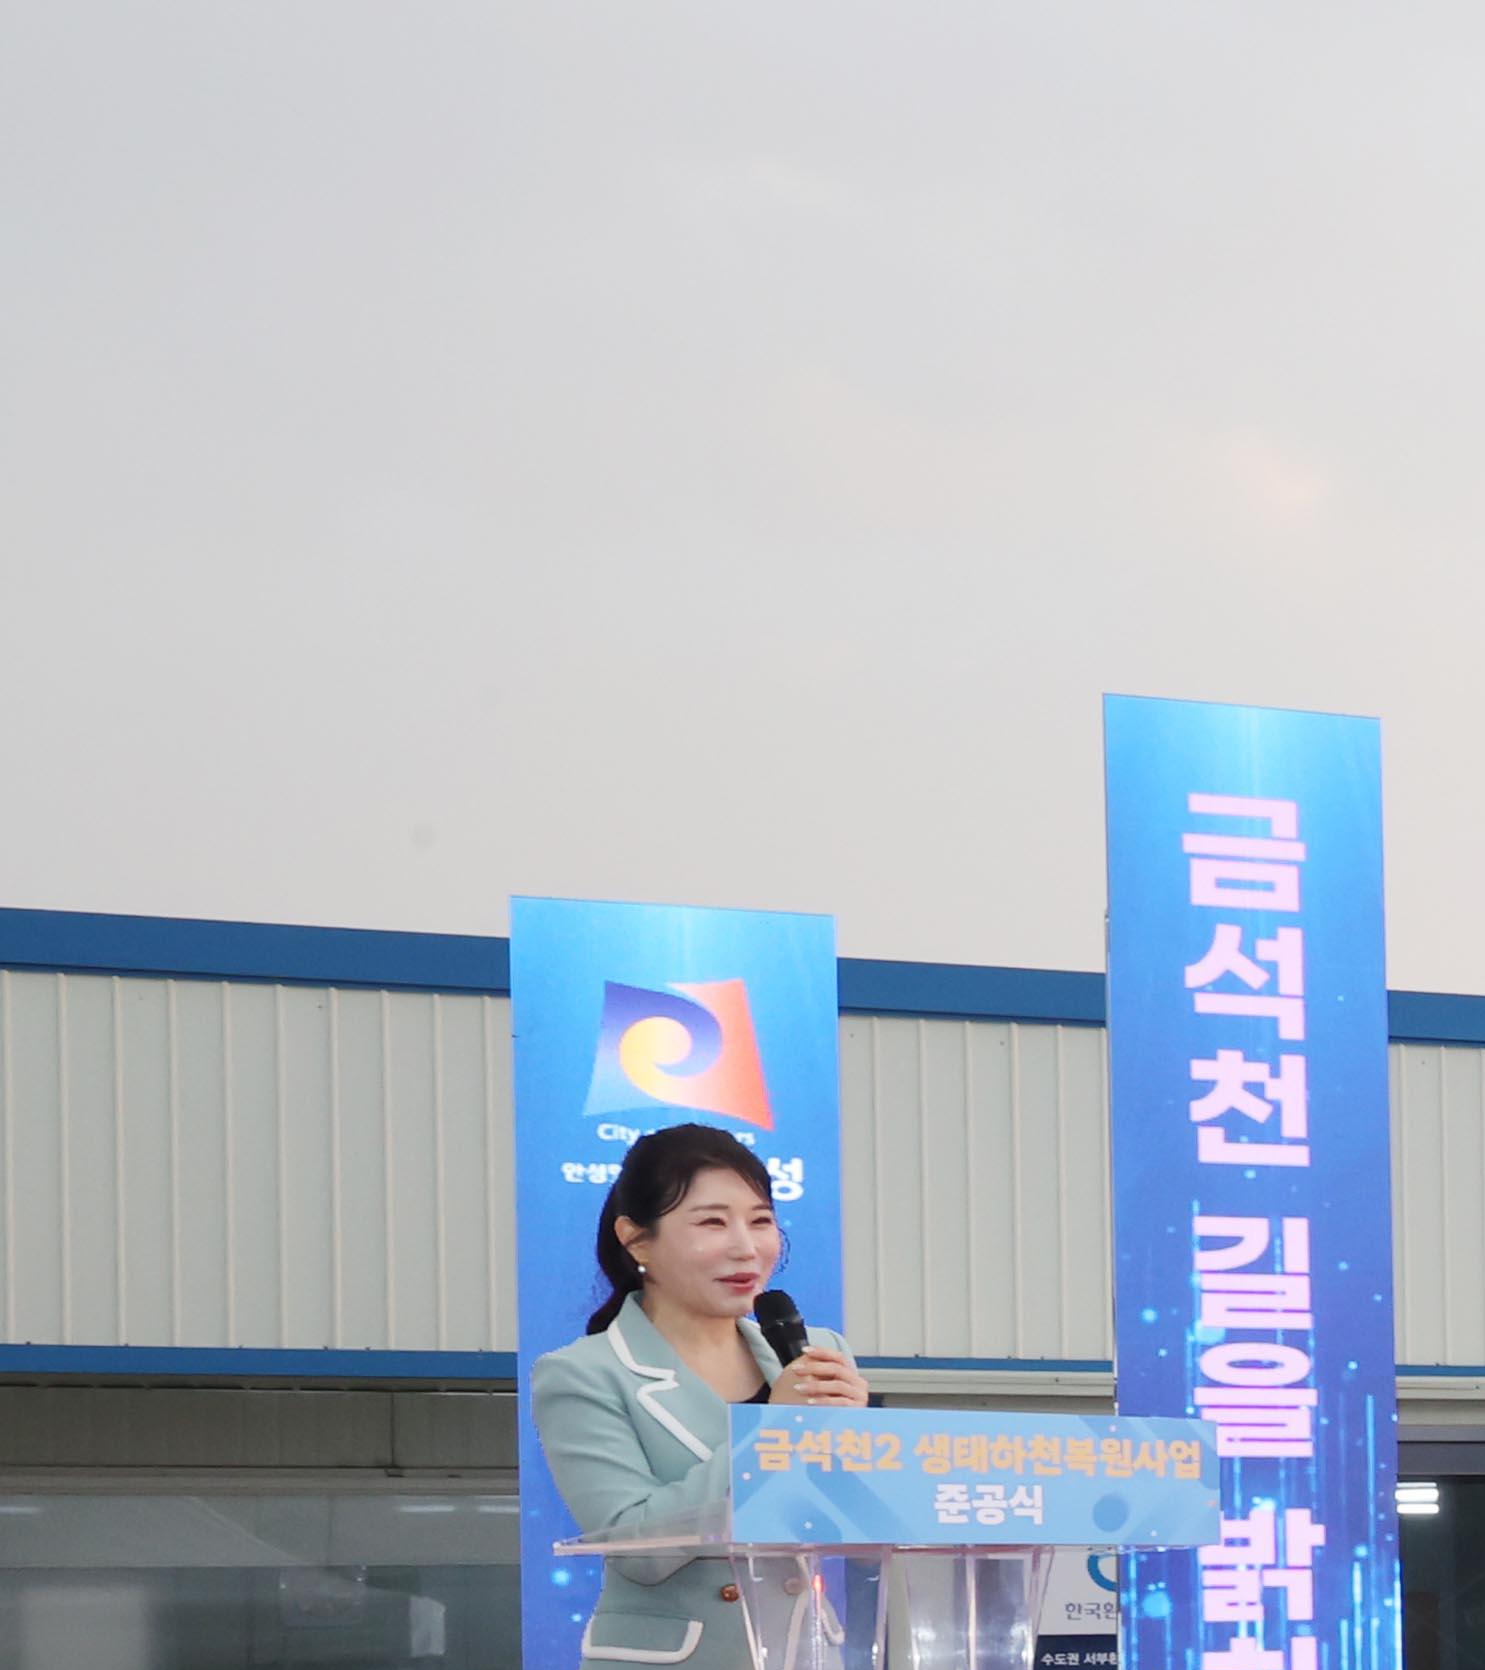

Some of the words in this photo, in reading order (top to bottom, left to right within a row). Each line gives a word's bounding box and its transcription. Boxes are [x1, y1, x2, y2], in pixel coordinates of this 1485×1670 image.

[1181, 793, 1310, 1167] 금석천
[596, 1123, 638, 1145] City
[1192, 1215, 1318, 1458] 길을
[753, 1429, 904, 1472] 금석천2
[914, 1433, 1202, 1480] 생태하천복원사업
[933, 1484, 1044, 1526] 준공식
